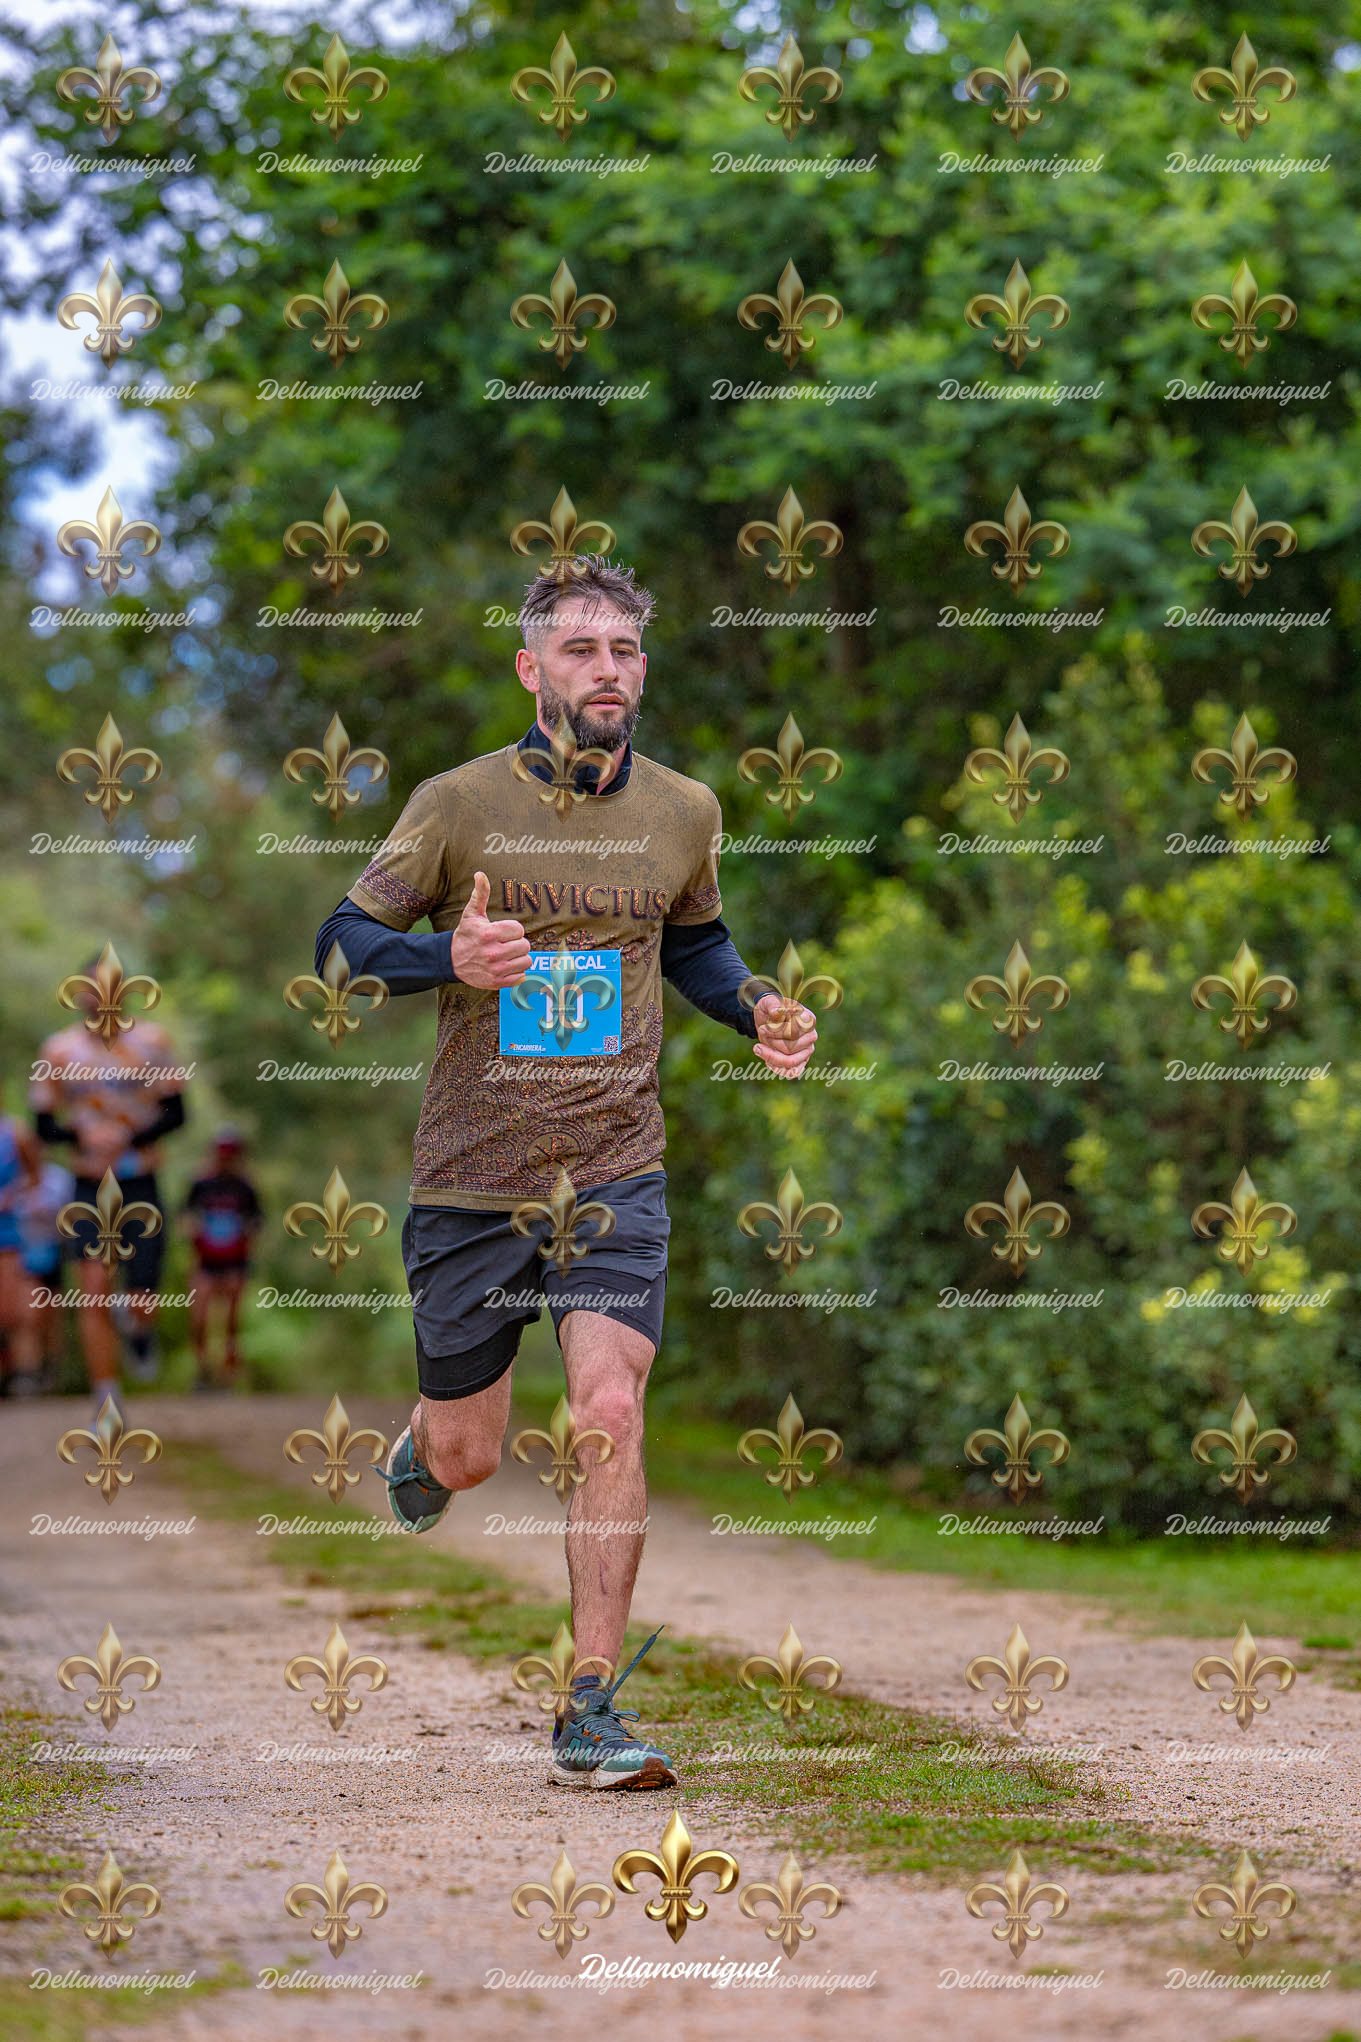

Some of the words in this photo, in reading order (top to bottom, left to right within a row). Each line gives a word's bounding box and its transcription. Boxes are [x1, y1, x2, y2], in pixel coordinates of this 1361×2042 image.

[503, 879, 670, 919] INVICTUS
[530, 955, 606, 970] VERTICAL
[539, 983, 583, 1028] 10
